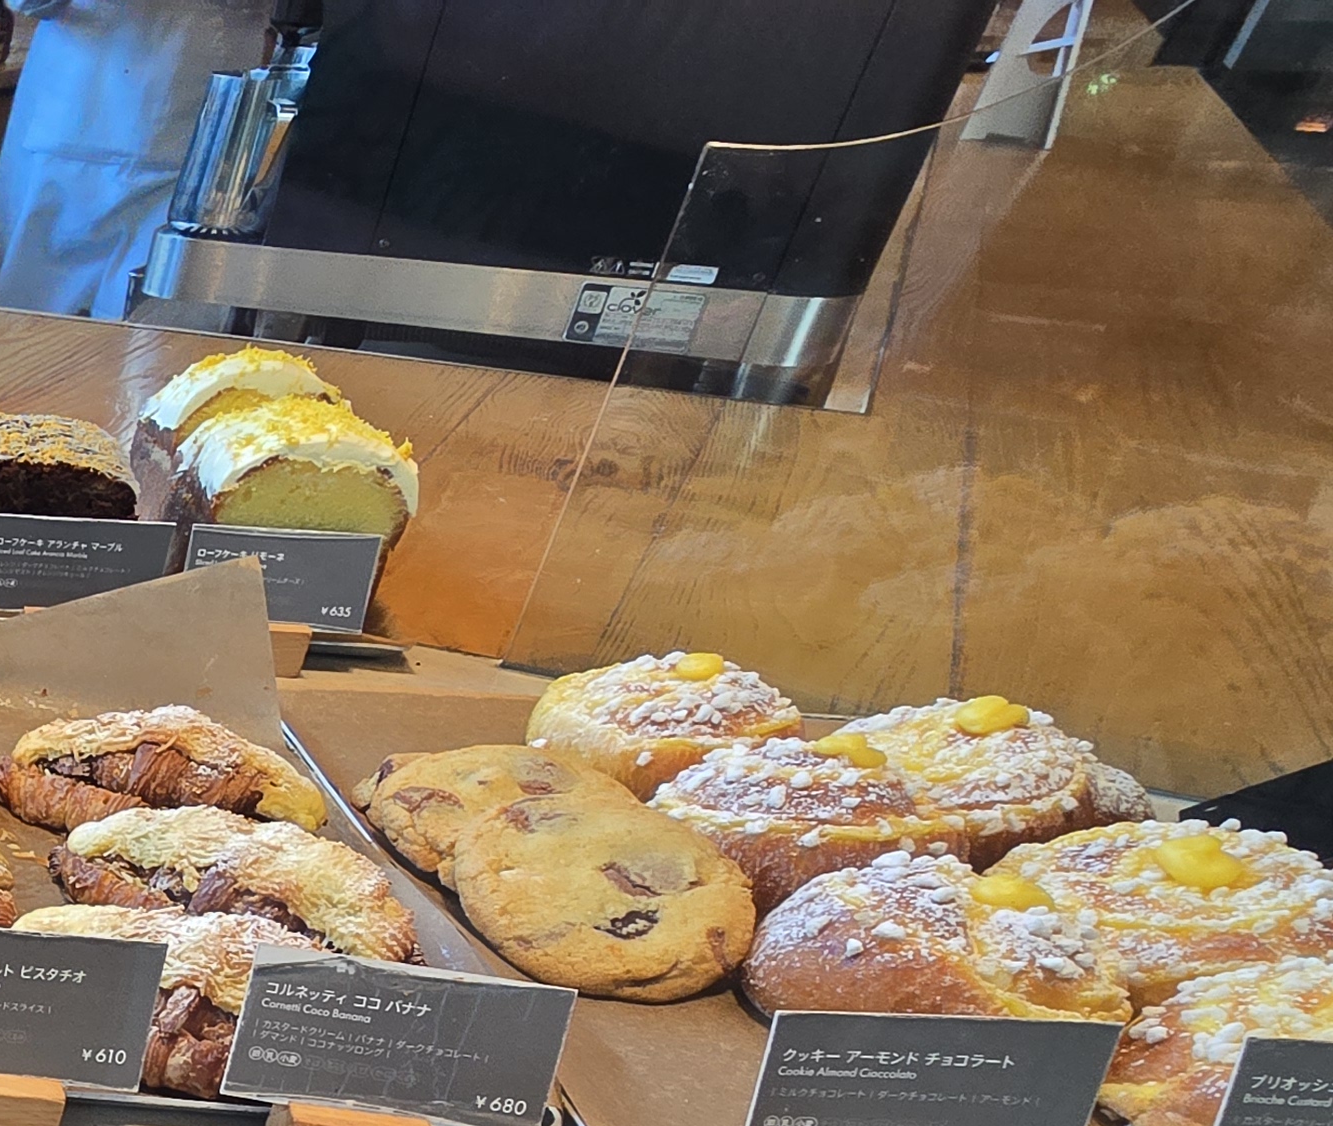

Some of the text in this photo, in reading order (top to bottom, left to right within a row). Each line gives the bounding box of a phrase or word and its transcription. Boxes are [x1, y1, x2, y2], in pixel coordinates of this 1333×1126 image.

[91, 542, 123, 553] マーブル
[321, 606, 351, 618] ¥635
[266, 982, 432, 1018] コルネッティ ココ バナナ
[261, 997, 371, 1024] Cornetti Coco Banana
[81, 1048, 127, 1065] ¥610
[783, 1047, 1016, 1069] クッキー アーモンド チョコラート
[777, 1065, 815, 1078] Cookie
[475, 1094, 527, 1116] ¥680
